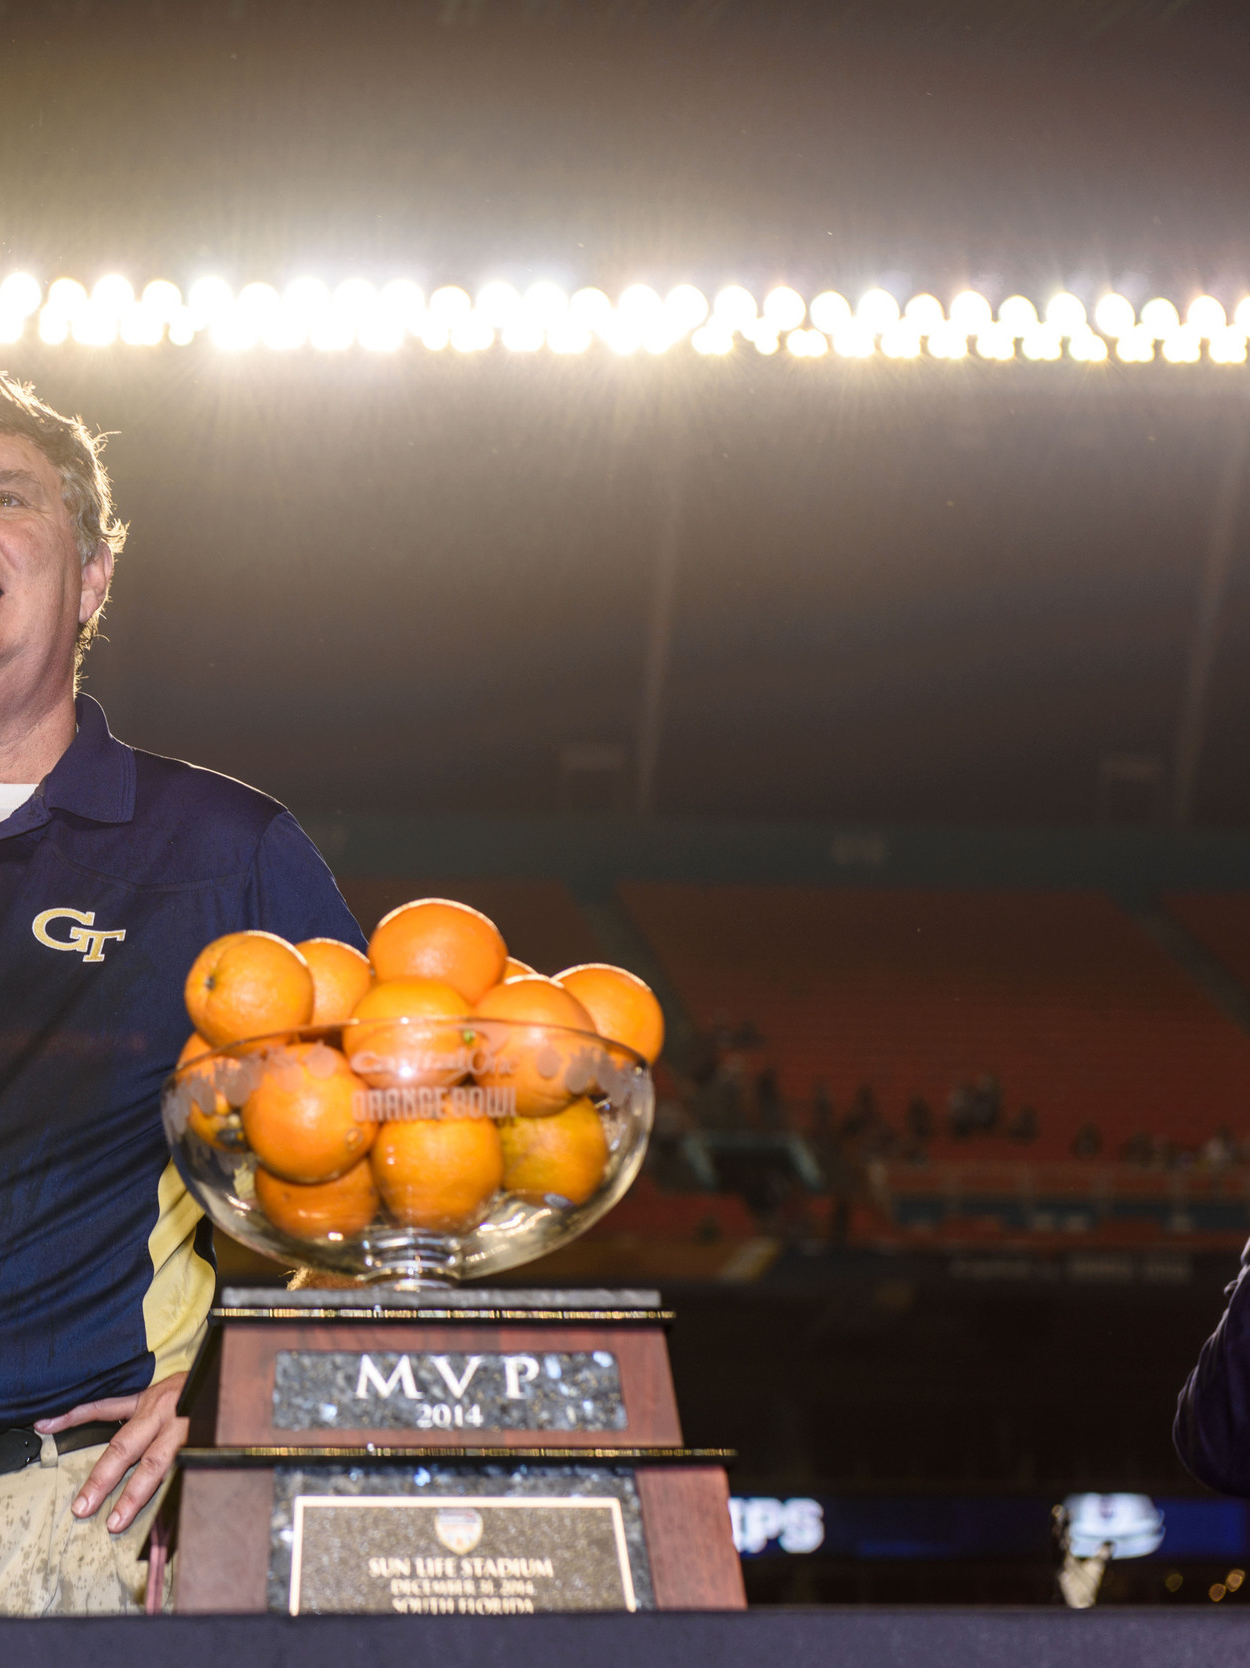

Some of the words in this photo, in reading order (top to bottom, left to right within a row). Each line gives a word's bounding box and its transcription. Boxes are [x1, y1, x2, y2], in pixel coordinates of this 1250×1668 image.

[32, 907, 126, 962] GT
[352, 1086, 448, 1123] ORANGE
[451, 1085, 518, 1119] BOWL
[416, 1403, 484, 1428] 2014
[368, 1557, 411, 1578] SUN
[415, 1557, 457, 1578] LIFE
[460, 1557, 555, 1578] STADIUM
